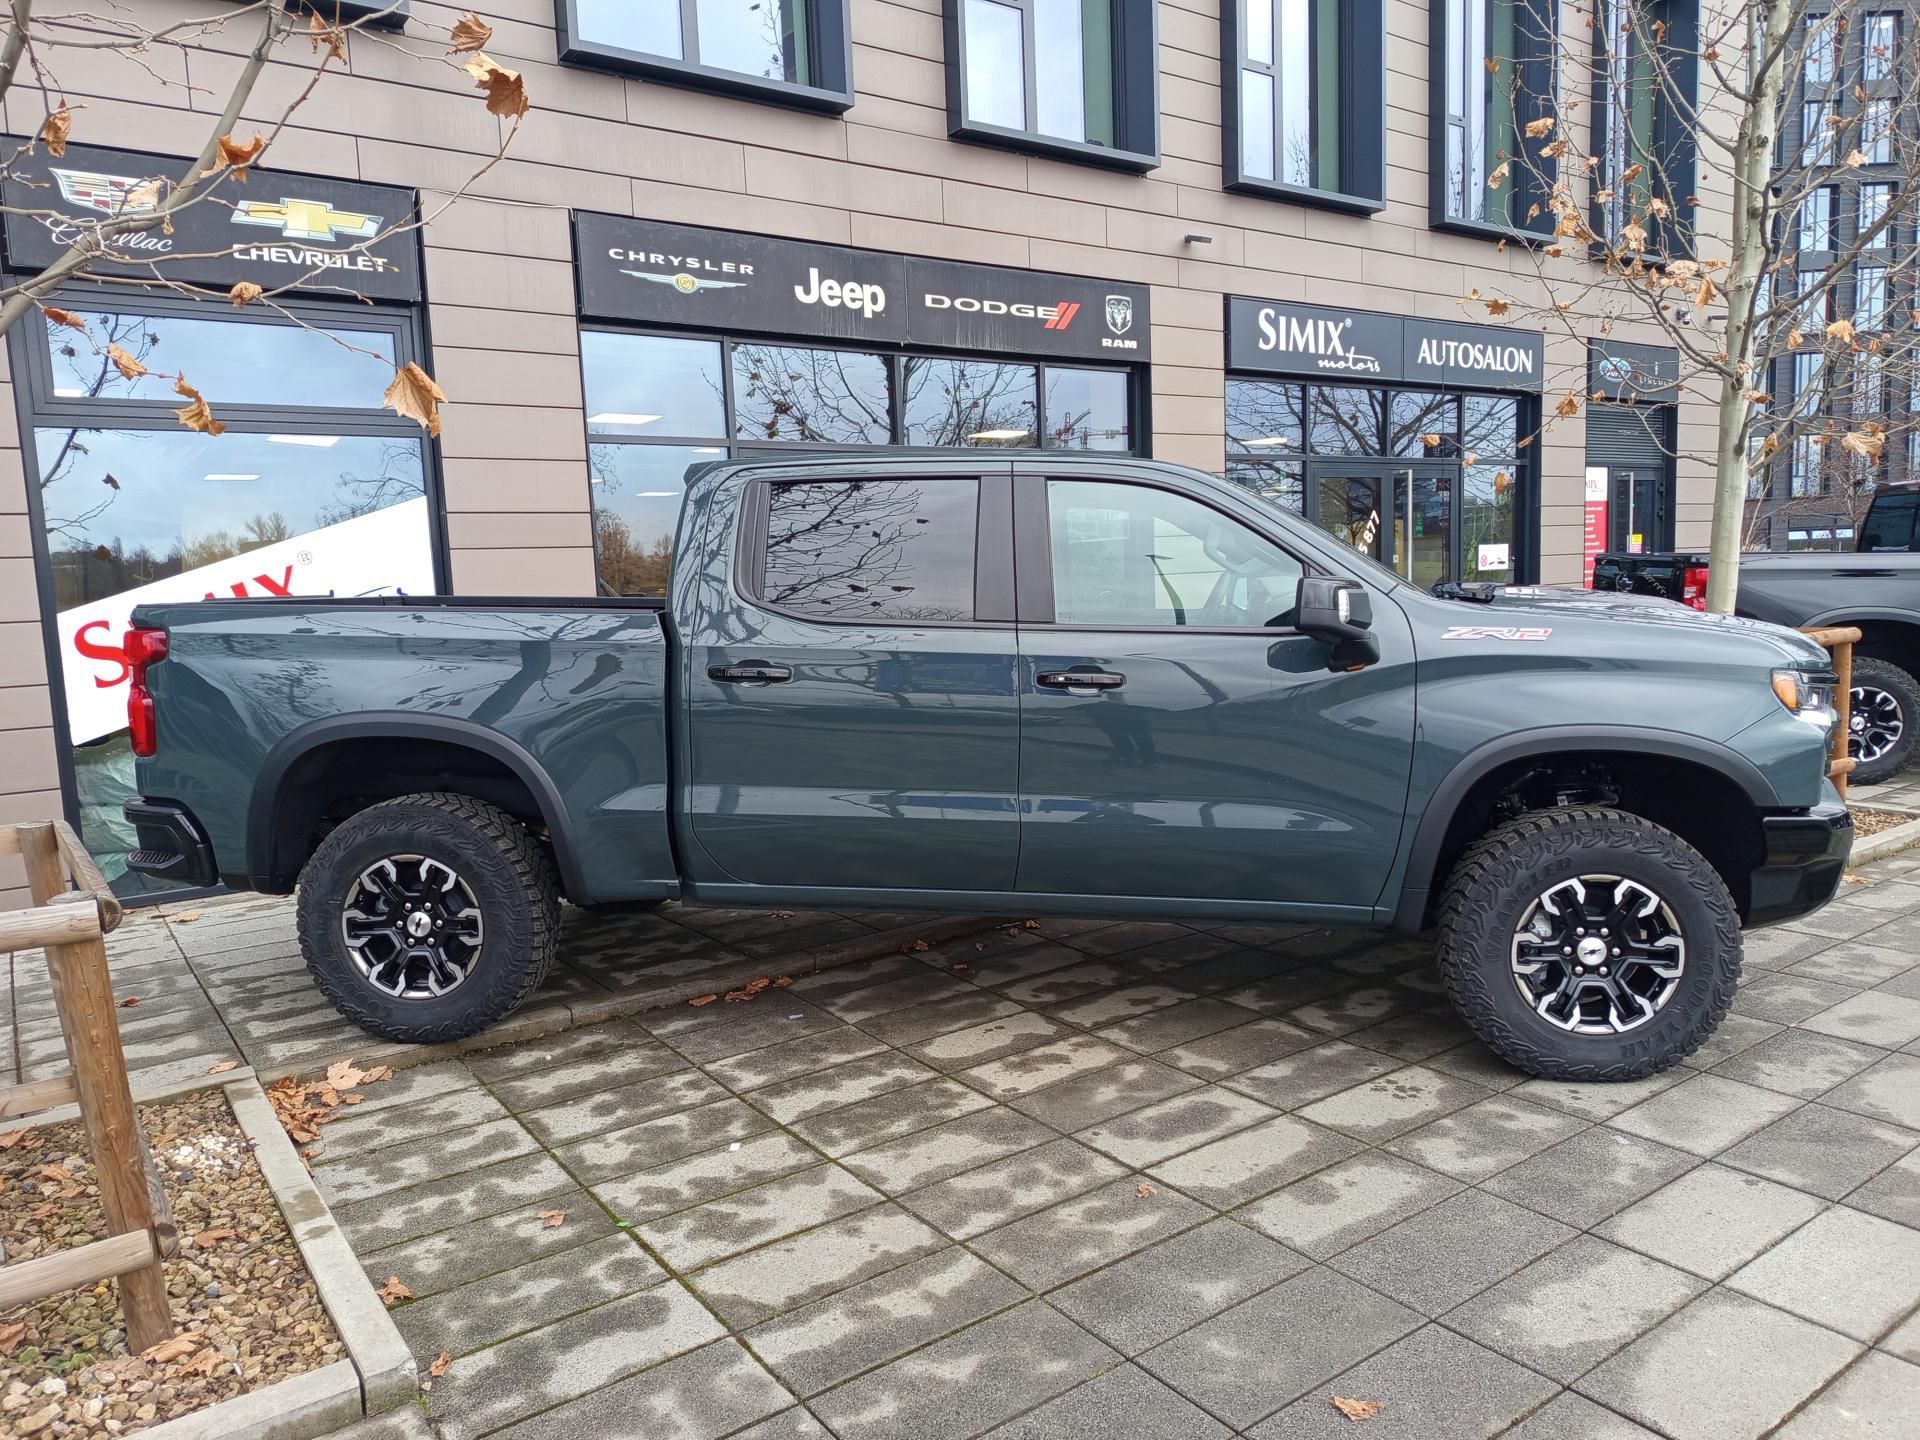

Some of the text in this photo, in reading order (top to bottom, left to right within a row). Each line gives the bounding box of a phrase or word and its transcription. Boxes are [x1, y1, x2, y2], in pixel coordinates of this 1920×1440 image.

[232, 244, 388, 272] CHEVROLET
[608, 248, 755, 275] CHRYSLER
[794, 267, 886, 318] Jeep
[924, 294, 1060, 320] DODGE
[1102, 338, 1138, 350] RAM
[1417, 338, 1533, 373] AUTOSALON
[1317, 346, 1381, 373] motors
[1363, 510, 1380, 544] 877
[1440, 626, 1553, 641] ZR2
